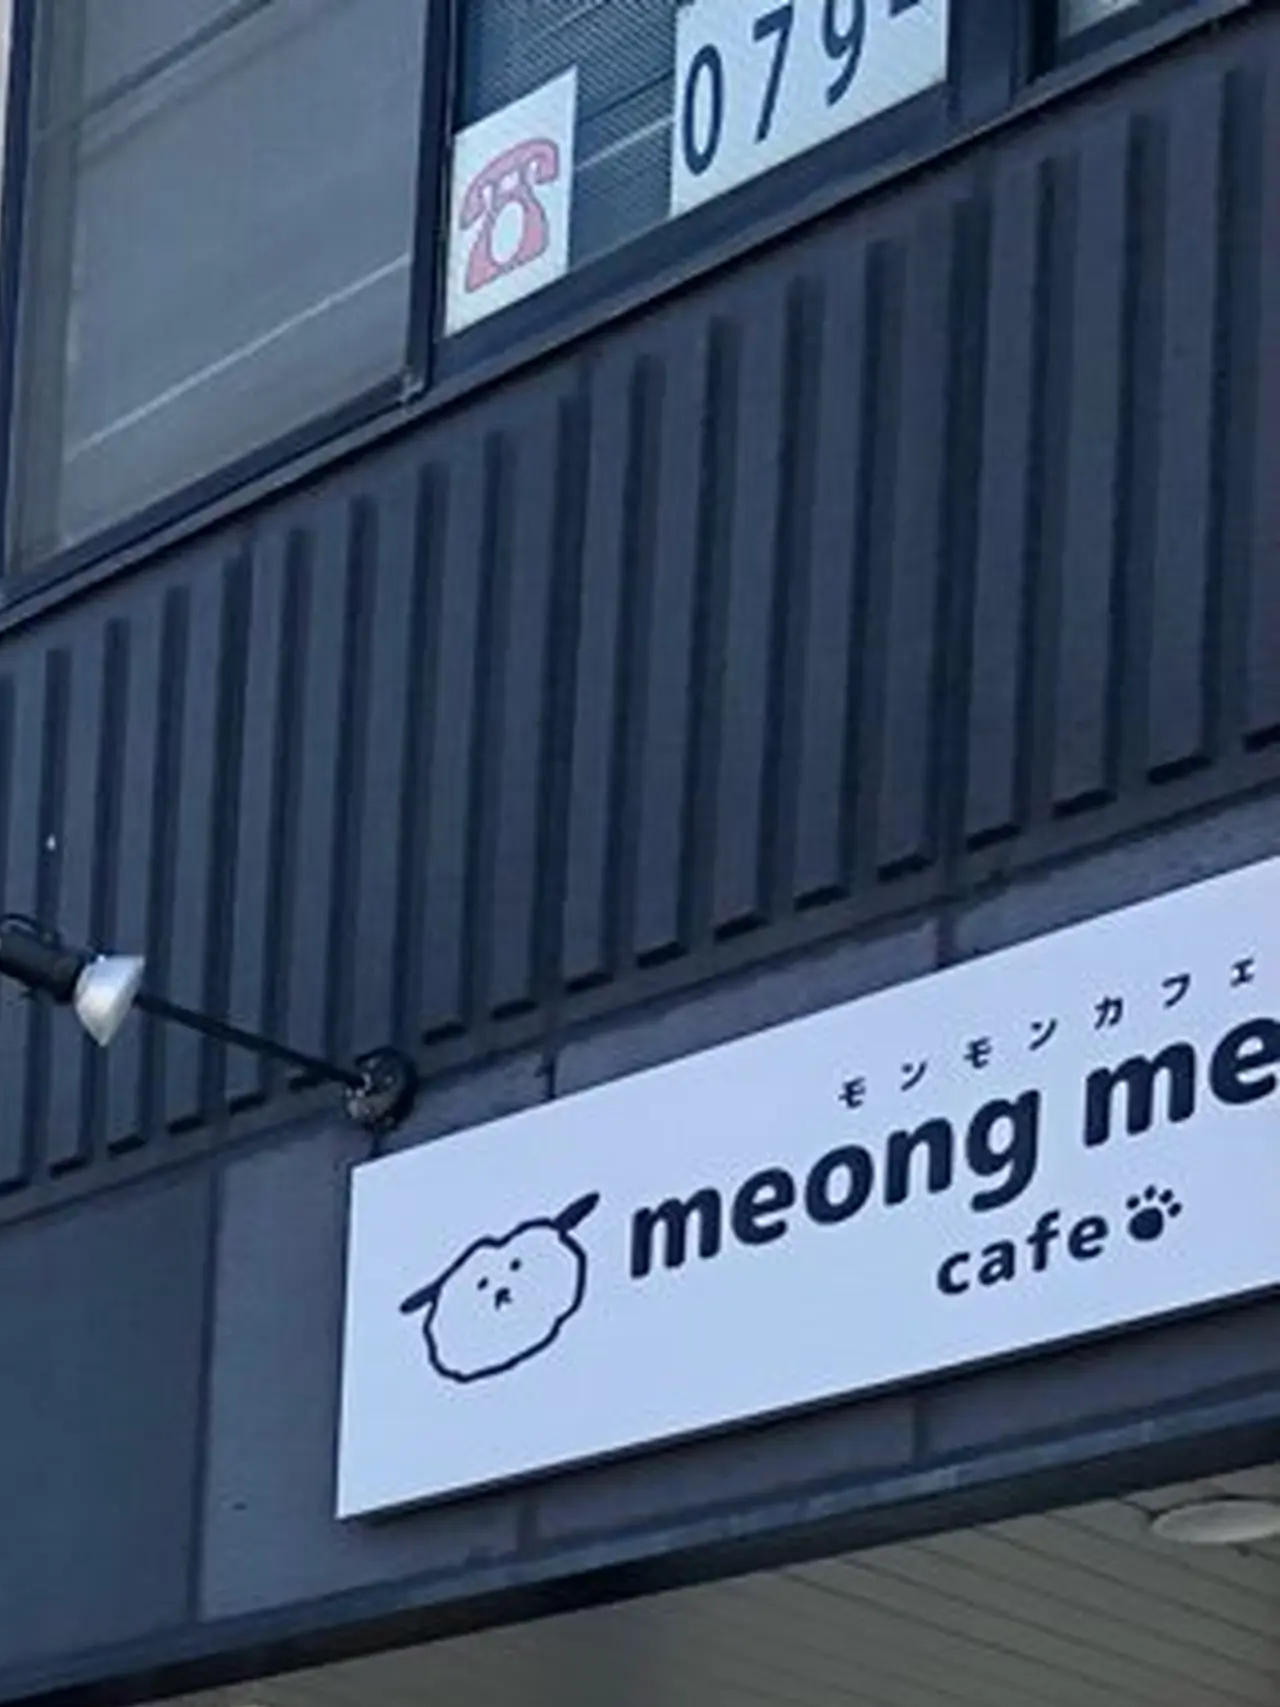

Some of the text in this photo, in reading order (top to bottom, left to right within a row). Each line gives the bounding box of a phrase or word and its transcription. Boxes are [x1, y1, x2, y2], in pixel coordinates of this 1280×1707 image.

[837, 957, 1255, 1108] モンモンカフェ
[628, 1087, 1041, 1278] meong
[938, 1208, 1109, 1296] cafe
